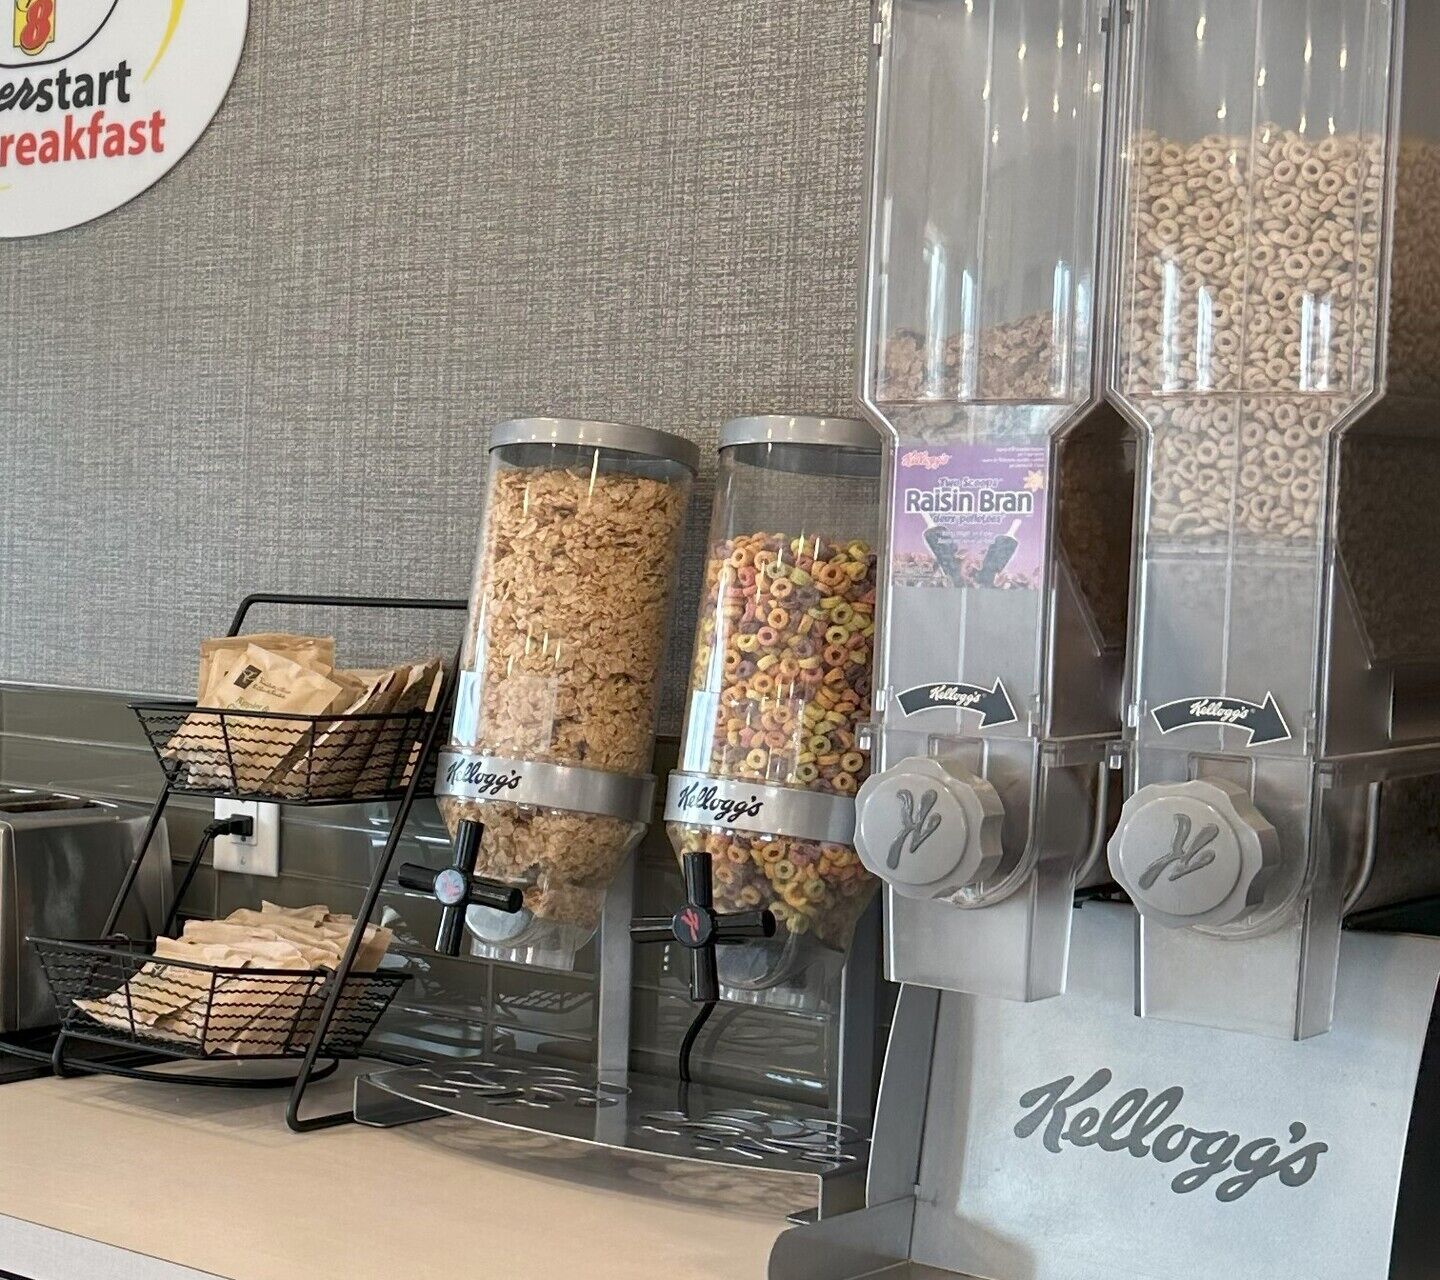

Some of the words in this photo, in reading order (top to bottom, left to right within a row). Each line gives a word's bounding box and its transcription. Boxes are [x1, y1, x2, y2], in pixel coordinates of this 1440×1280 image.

[905, 488, 974, 513] Raisin
[978, 488, 1034, 513] Bran
[929, 684, 982, 705] Kellogg's
[1189, 699, 1249, 722] Kellogg's
[446, 758, 522, 795] Kellogg's
[678, 782, 764, 820] Kellogg's
[1013, 1068, 1329, 1203] Kellogg's
